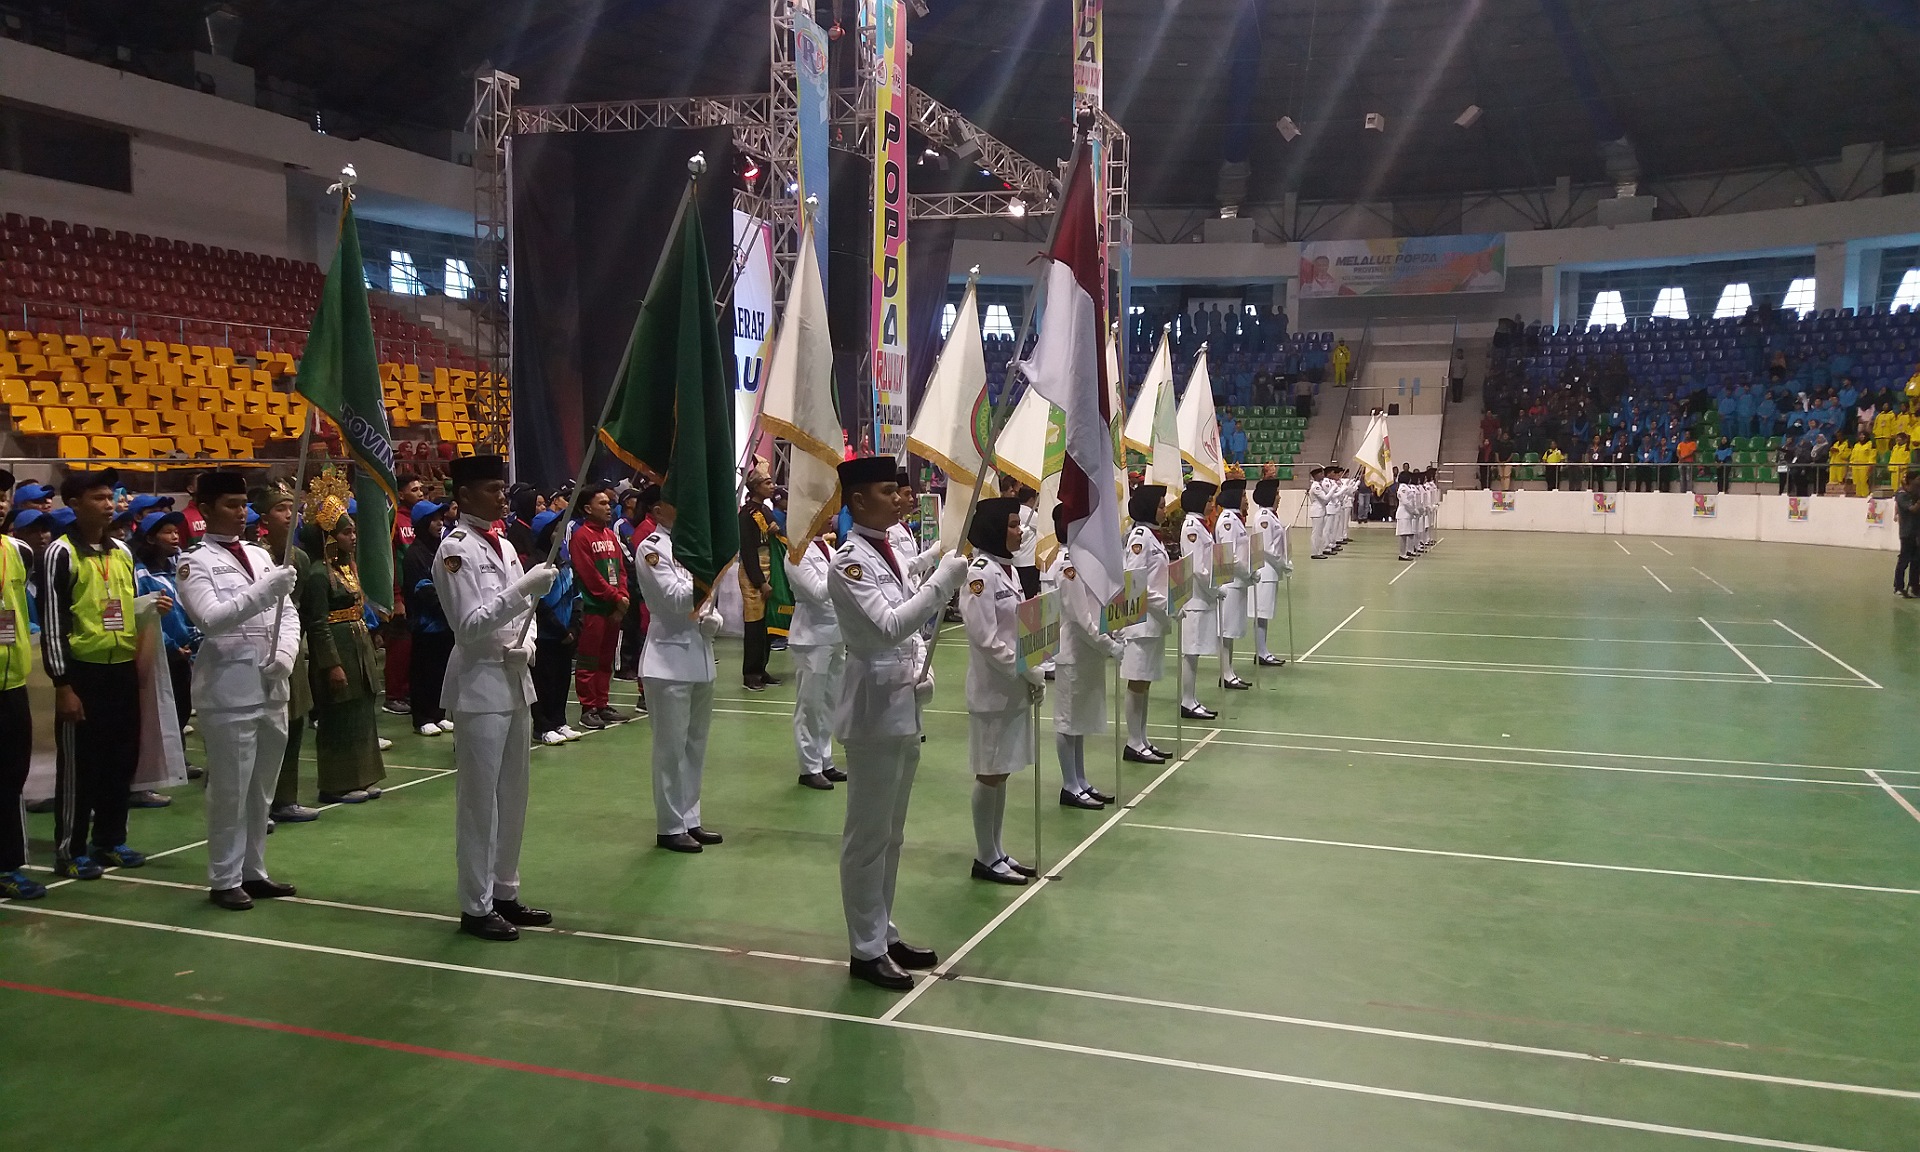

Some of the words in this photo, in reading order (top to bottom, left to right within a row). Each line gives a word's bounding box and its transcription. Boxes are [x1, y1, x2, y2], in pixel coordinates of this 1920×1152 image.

[882, 110, 901, 347] POPDA
[1335, 255, 1392, 266] MELALUI
[1395, 253, 1437, 264] POPDA
[1107, 597, 1140, 621] DUMAI
